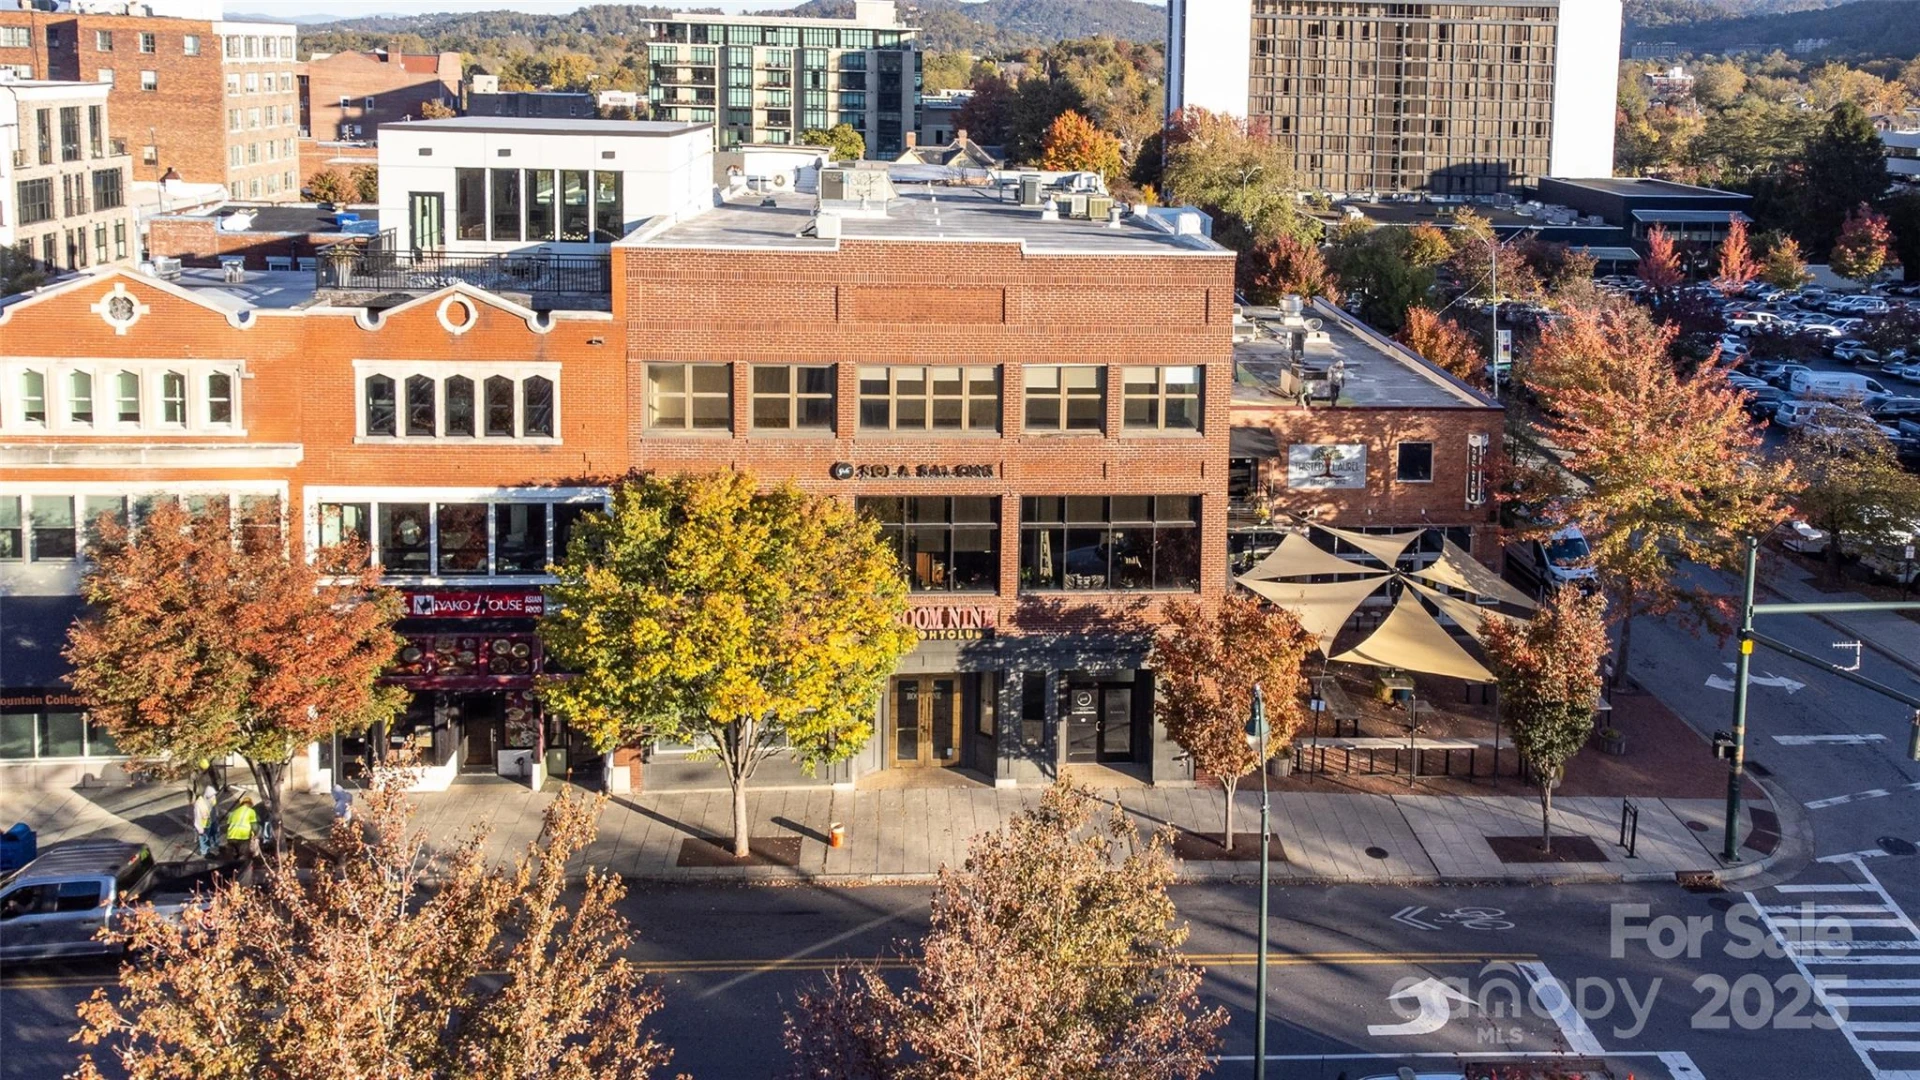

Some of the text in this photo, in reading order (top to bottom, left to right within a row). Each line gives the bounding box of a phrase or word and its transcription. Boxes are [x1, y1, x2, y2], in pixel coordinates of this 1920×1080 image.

[525, 605, 542, 613] FOOD
[948, 606, 994, 628] NINE
[0, 695, 42, 706] ountain
